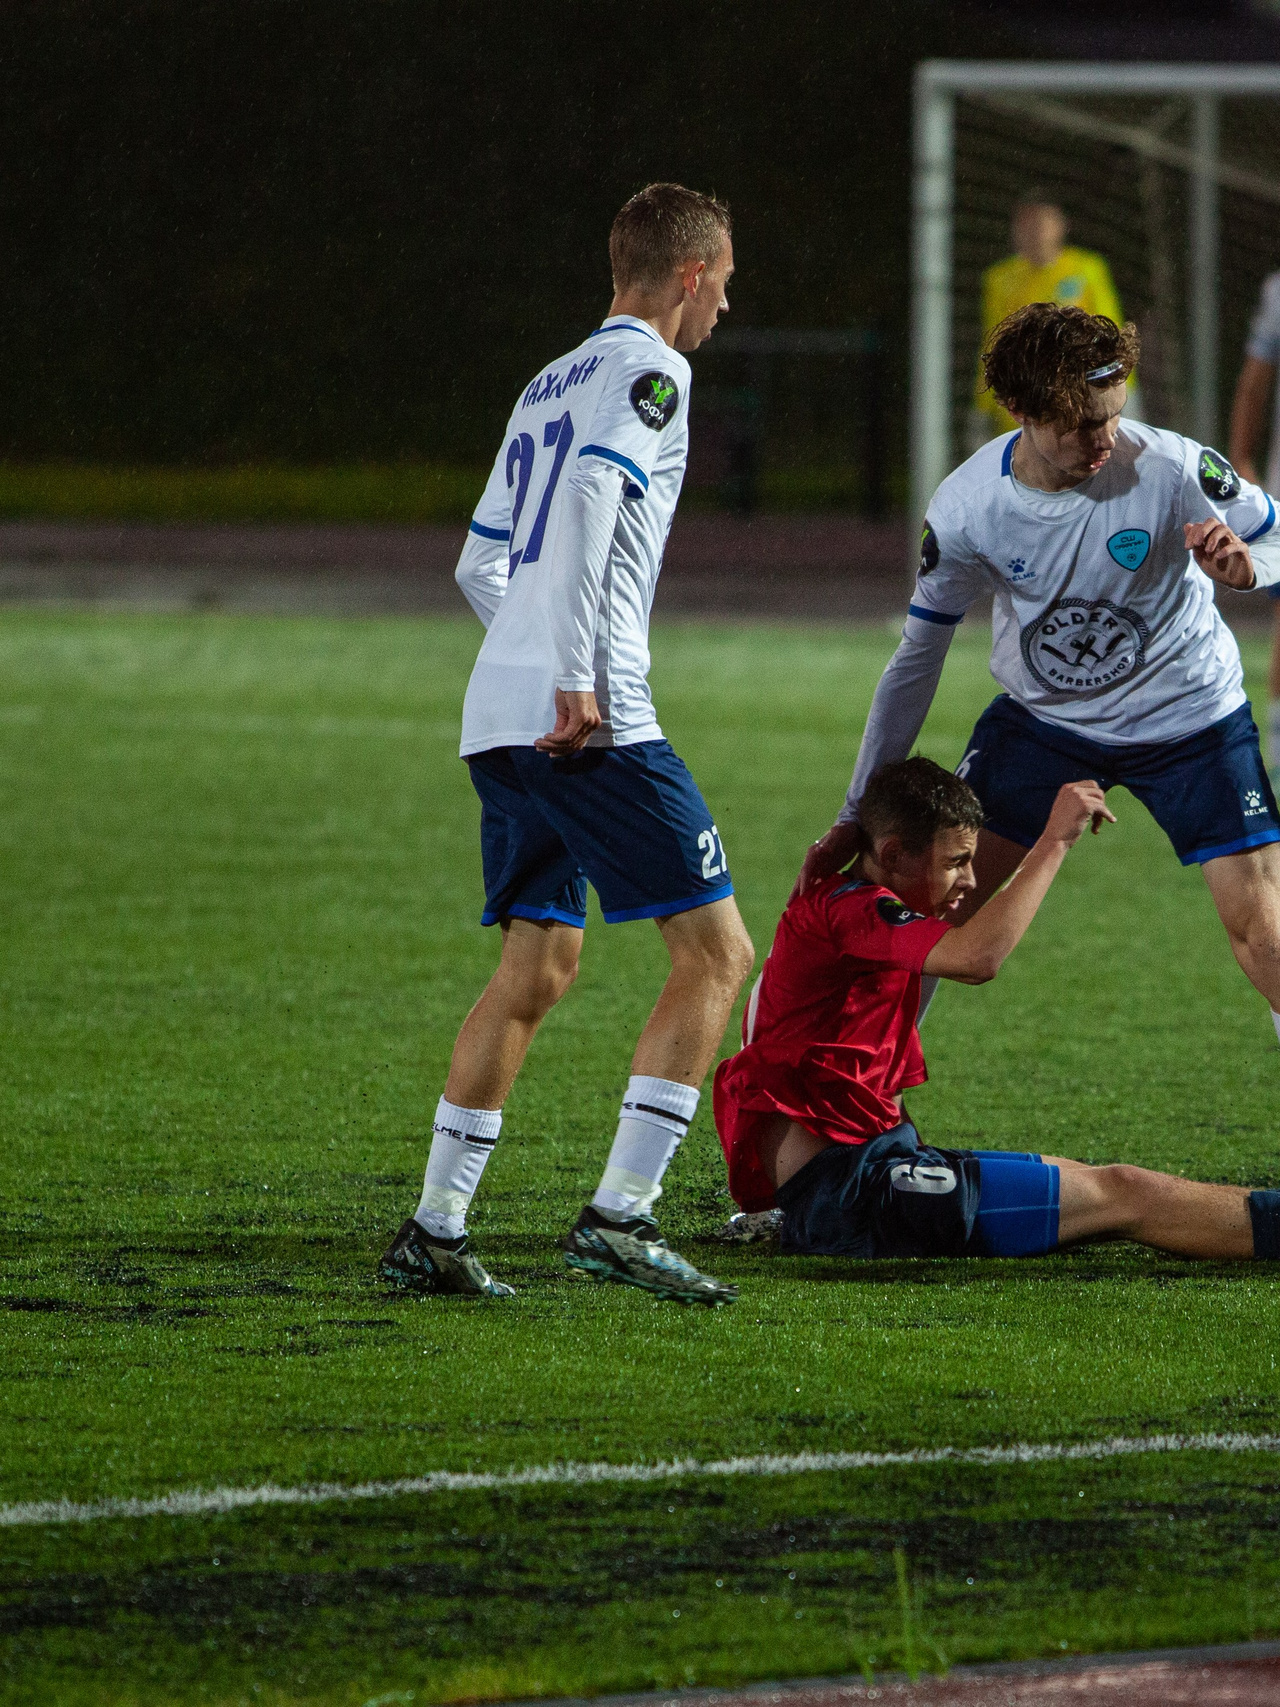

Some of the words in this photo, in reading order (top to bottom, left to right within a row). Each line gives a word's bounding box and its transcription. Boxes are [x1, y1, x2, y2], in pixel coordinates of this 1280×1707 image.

[638, 398, 665, 424] ЮФЛ
[506, 410, 575, 580] 27
[1041, 612, 1118, 636] OLDER
[1048, 656, 1130, 687] BARBERSHOP
[1243, 806, 1268, 817] KELME
